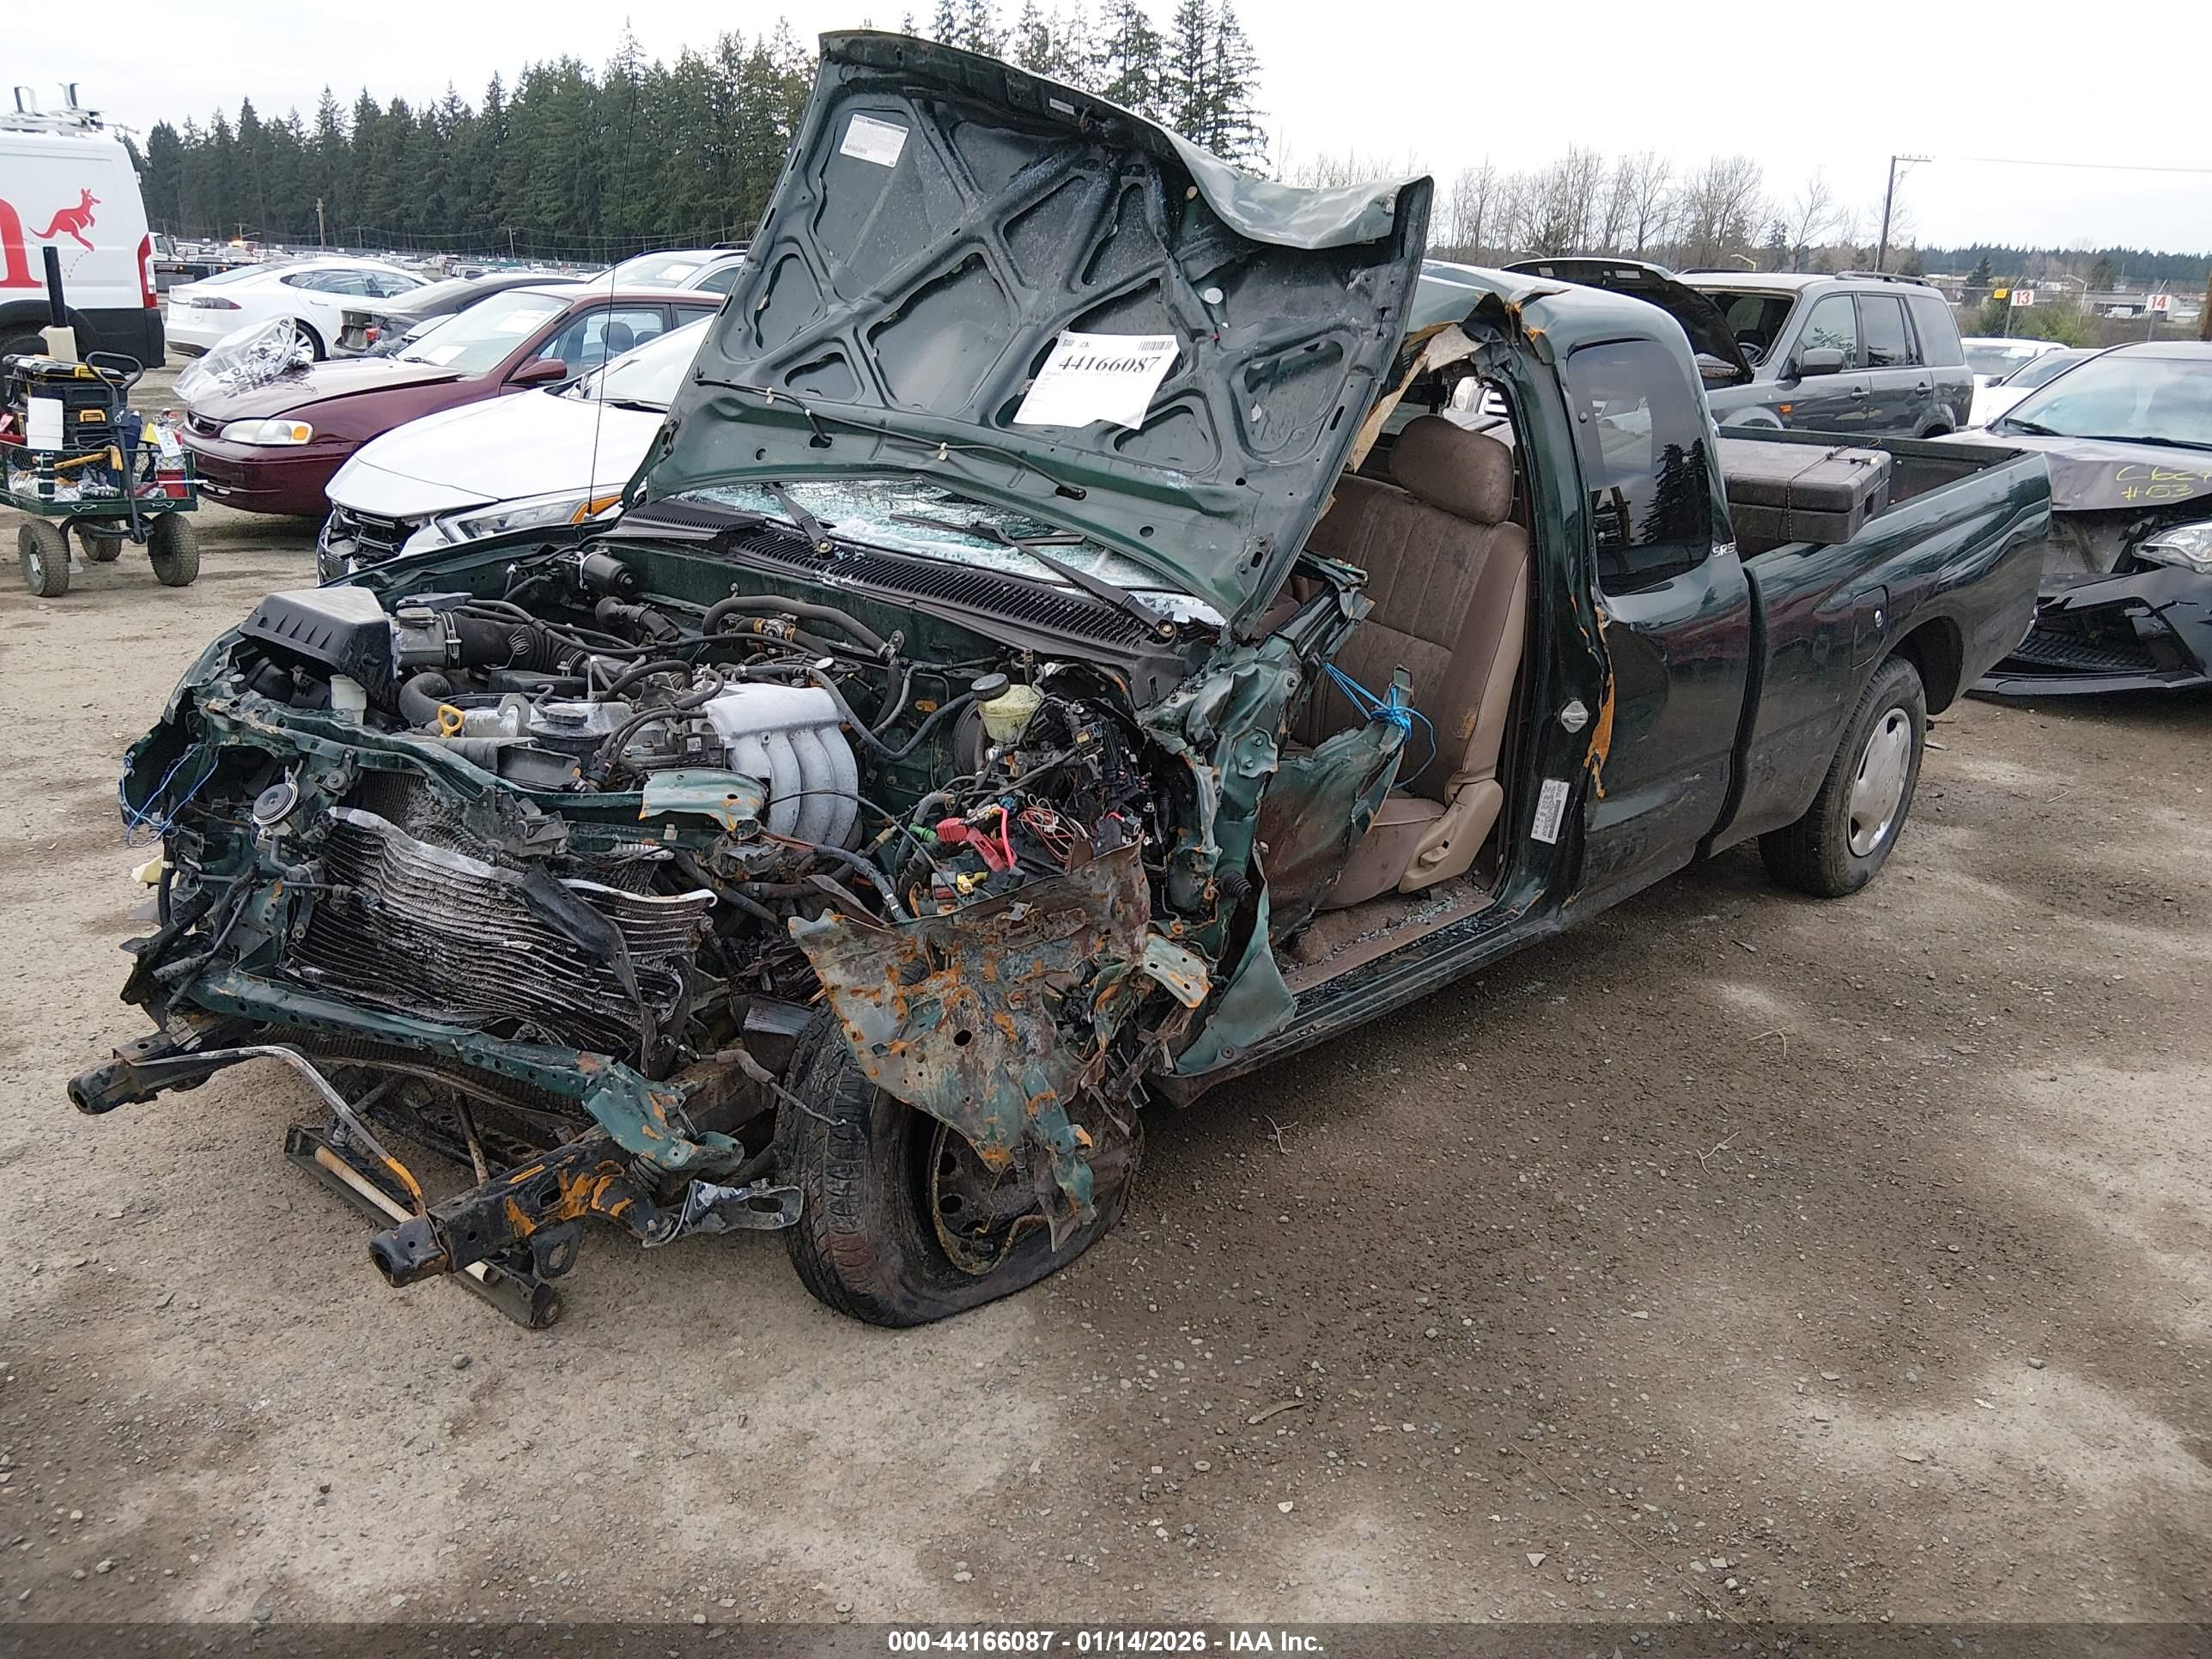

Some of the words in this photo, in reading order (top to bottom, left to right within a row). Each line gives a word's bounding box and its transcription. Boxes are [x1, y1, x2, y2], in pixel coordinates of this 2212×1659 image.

[2016, 291, 2030, 305] 13
[2152, 295, 2168, 309] 14
[1059, 355, 1162, 374] 44166087
